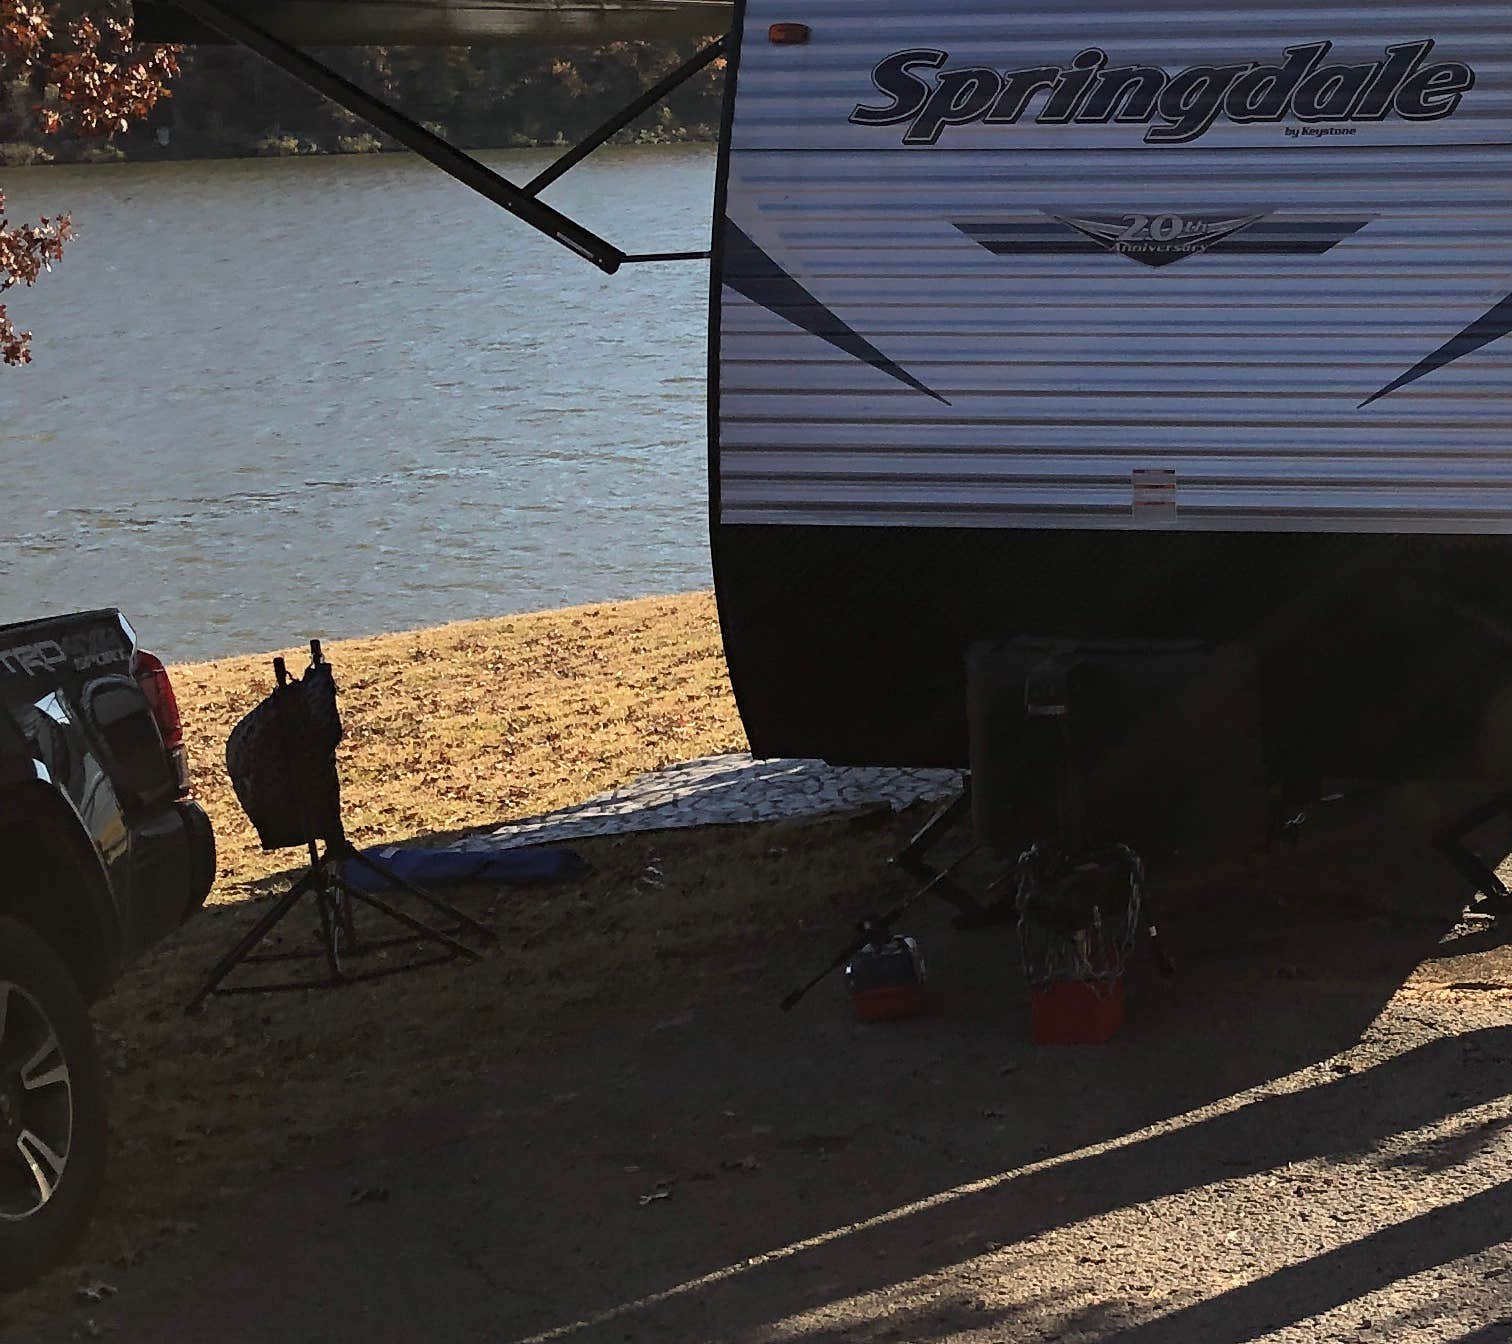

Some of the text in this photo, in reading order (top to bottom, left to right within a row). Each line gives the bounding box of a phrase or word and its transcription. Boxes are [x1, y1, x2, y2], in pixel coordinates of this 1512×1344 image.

[849, 39, 1476, 145] Springdale
[1284, 126, 1357, 137] by Keystone
[1118, 213, 1208, 242] 20th
[1110, 242, 1208, 253] Anniversary
